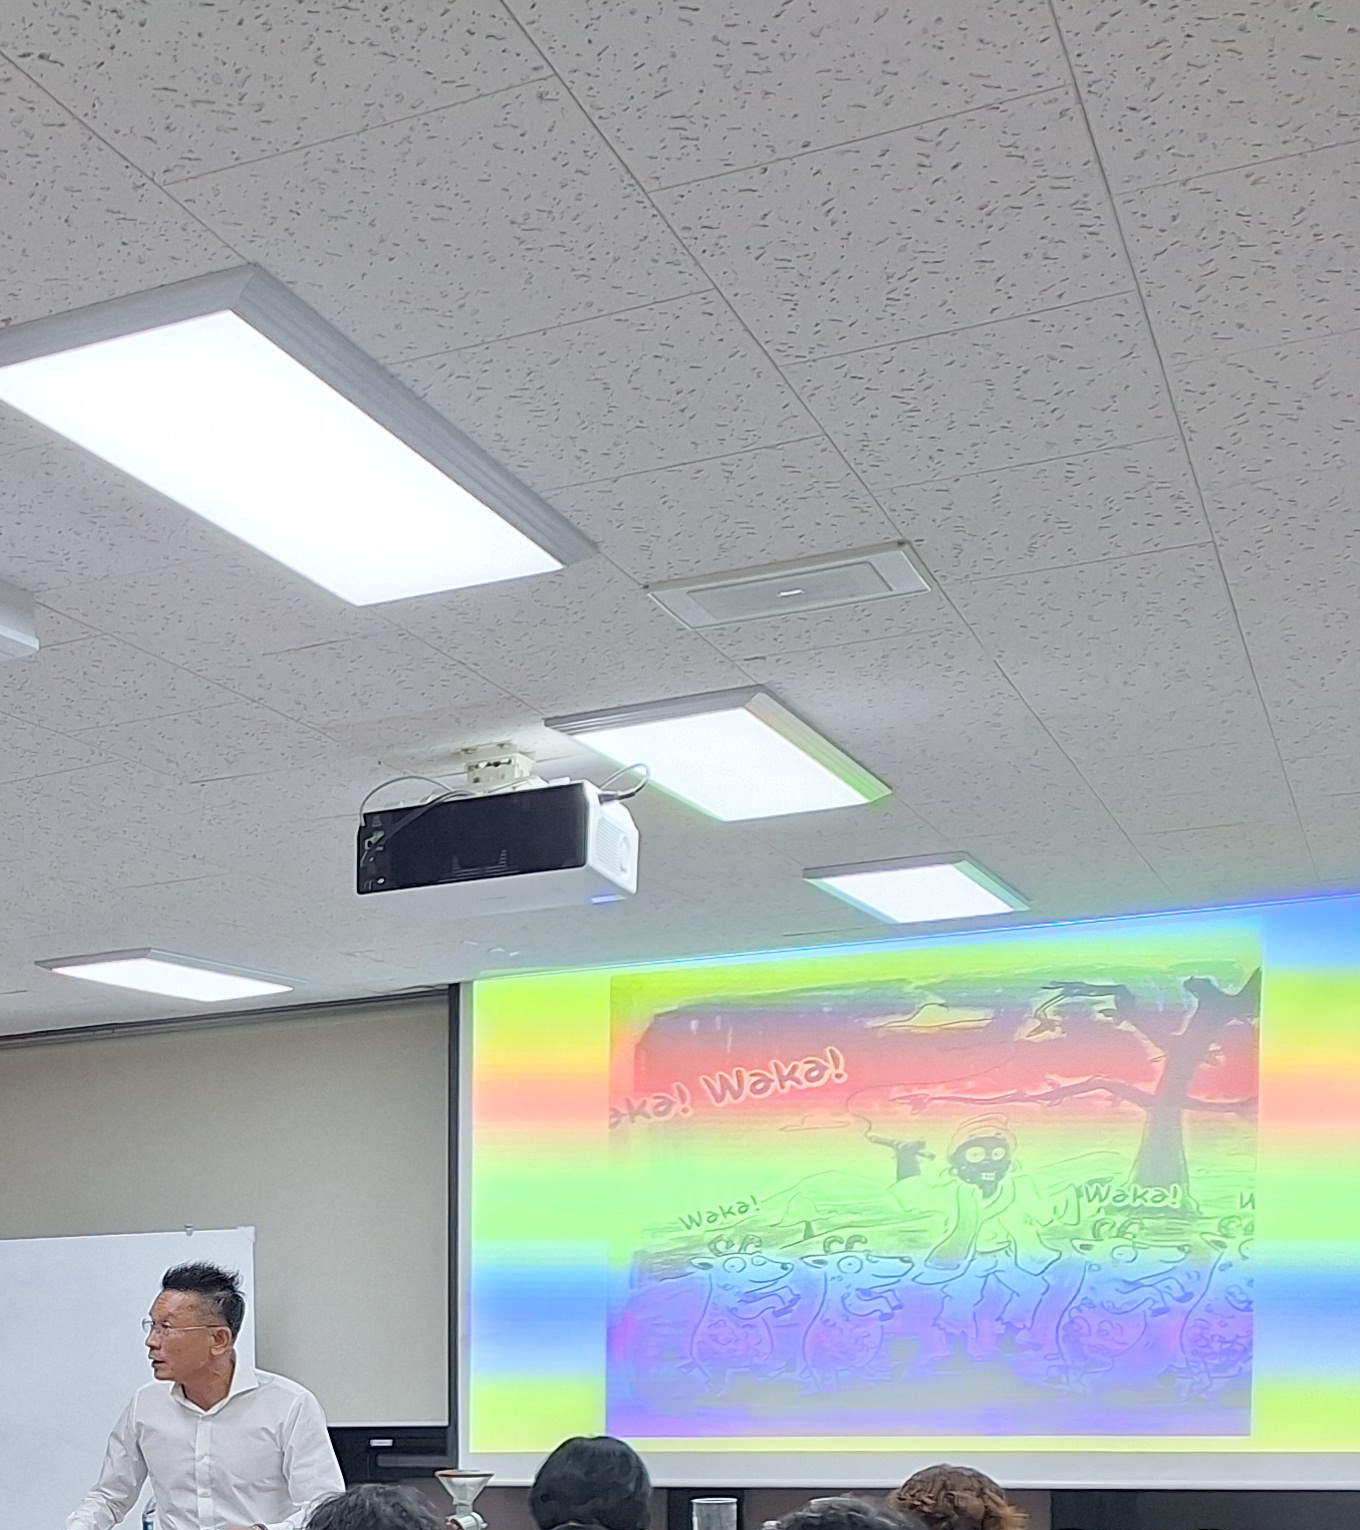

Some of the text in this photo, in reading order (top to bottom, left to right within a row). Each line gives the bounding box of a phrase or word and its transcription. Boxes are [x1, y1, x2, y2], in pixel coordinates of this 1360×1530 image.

[700, 1046, 848, 1106] Waka!
[678, 1194, 760, 1230] Waka!
[1084, 1184, 1179, 1206] Waka!
